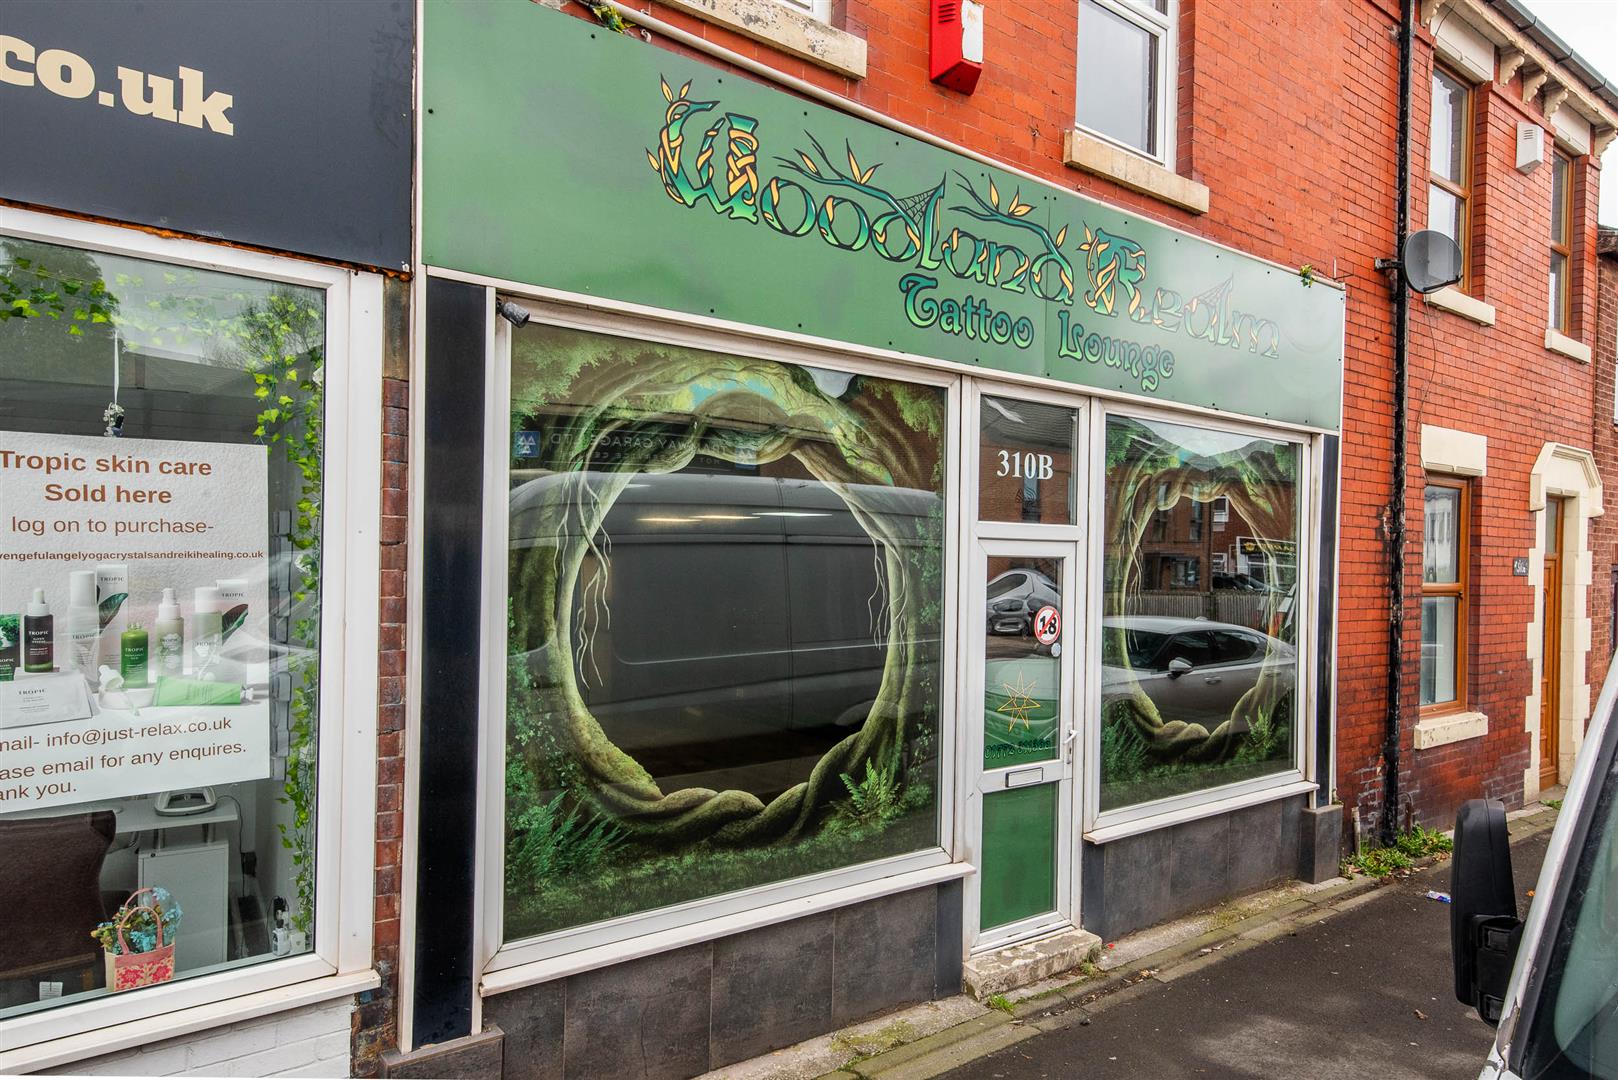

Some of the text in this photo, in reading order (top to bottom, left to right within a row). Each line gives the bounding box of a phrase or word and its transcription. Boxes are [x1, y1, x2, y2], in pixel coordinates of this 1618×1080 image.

[655, 98, 1280, 359] Woodland Realm
[900, 272, 1176, 392] Tattoo Lounge
[0, 450, 213, 476] Tropic skin care
[996, 449, 1054, 480] 310B
[44, 483, 173, 504] Sold here
[12, 516, 214, 537] log on to purchase-
[1039, 615, 1058, 635] 18
[47, 717, 232, 748] info@just-relax.co.uk
[42, 756, 94, 776] email
[101, 754, 125, 769] for
[131, 750, 163, 766] any
[169, 740, 247, 761] enquires.
[36, 782, 77, 800] you.
